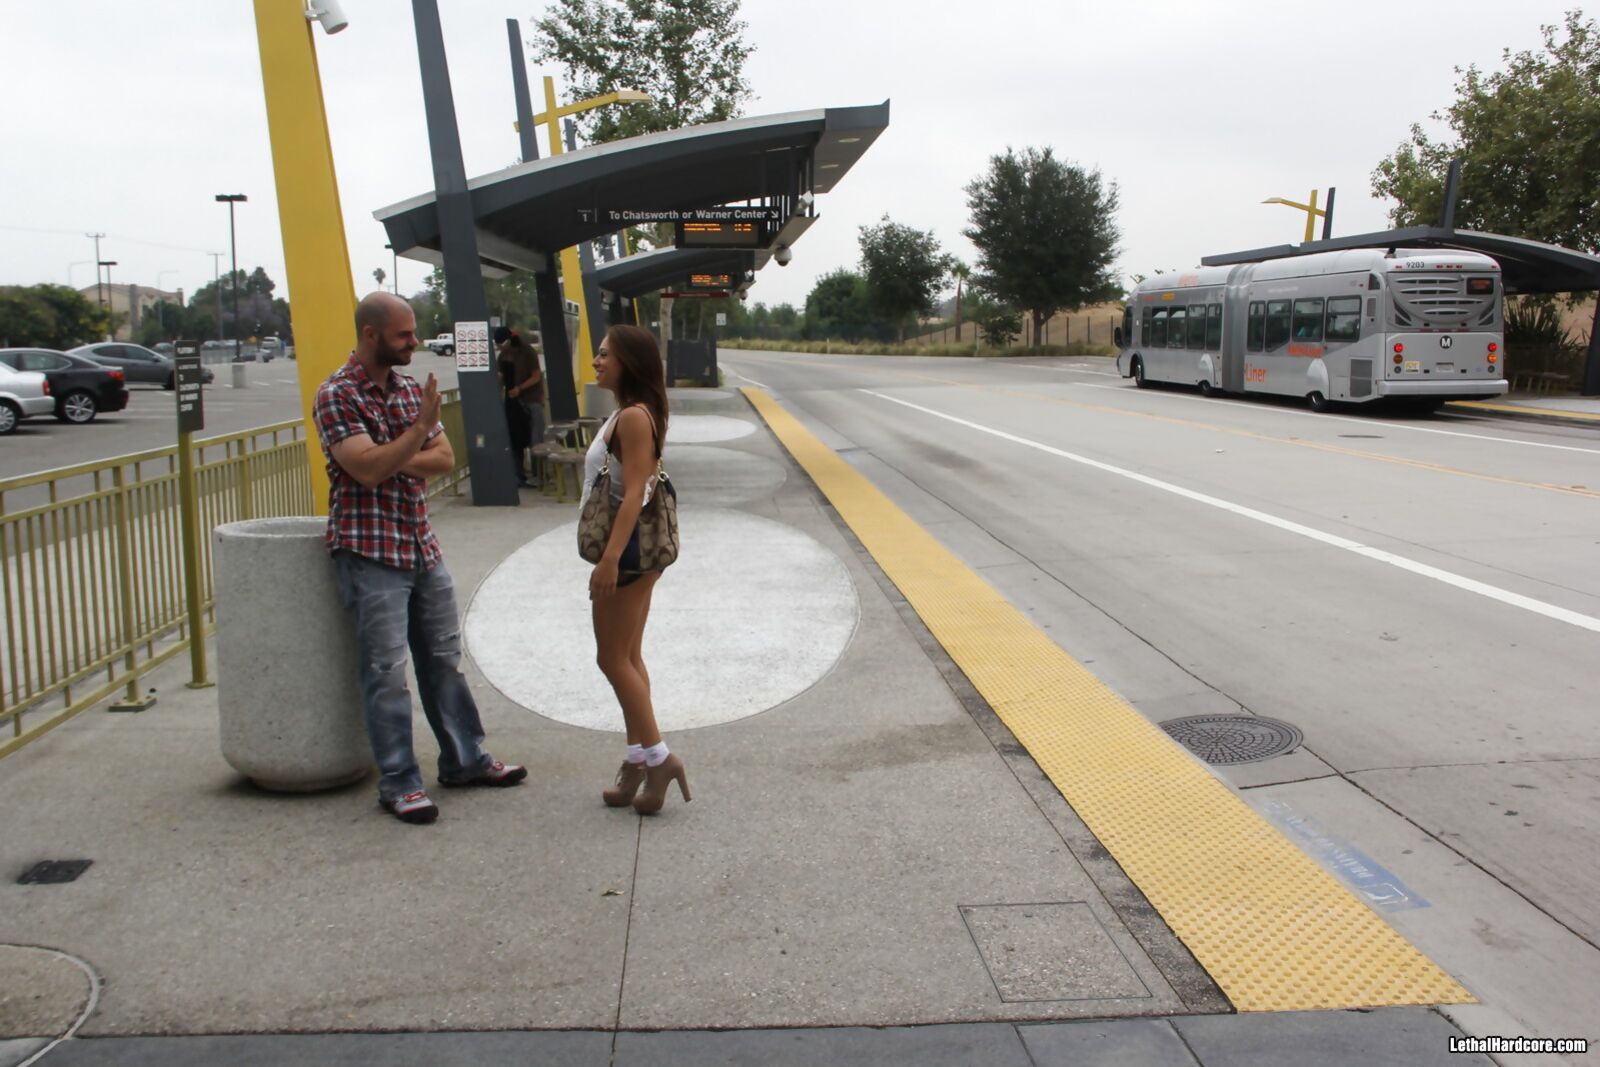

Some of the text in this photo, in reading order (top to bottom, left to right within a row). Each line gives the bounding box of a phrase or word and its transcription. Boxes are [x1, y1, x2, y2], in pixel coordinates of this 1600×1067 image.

[582, 213, 588, 222] 1
[609, 209, 767, 220] To Chatsworth or Warner Center
[1406, 261, 1425, 269] 9203
